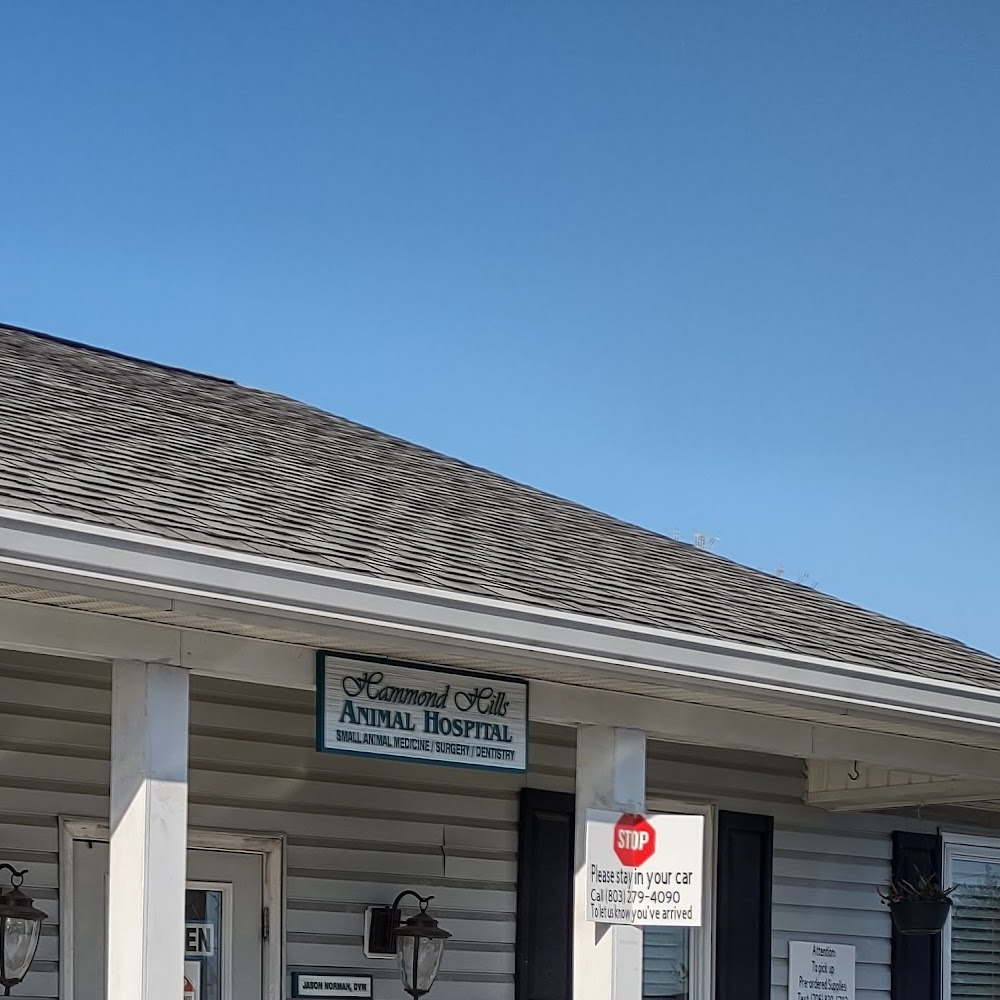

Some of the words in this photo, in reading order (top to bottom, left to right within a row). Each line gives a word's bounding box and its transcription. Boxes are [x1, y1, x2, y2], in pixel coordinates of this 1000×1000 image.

[342, 671, 450, 708] Hammond
[454, 687, 510, 717] Hills
[339, 700, 415, 731] ANIMAL
[423, 709, 513, 742] HOSPITAL
[336, 729, 361, 744] SMALL
[363, 732, 392, 747] ANIMAL
[393, 736, 429, 752] MEDICINE
[435, 741, 470, 757] SURGERY
[476, 745, 516, 761] DENTISTRY
[618, 829, 649, 851] STOP
[591, 864, 614, 884] Please
[616, 868, 633, 889] stay
[634, 868, 643, 884] in
[646, 872, 672, 890] your
[675, 872, 693, 885] car
[591, 888, 604, 902] Call
[605, 889, 626, 904] (803)
[627, 890, 681, 904] 279-4090
[591, 903, 599, 918] To
[608, 909, 614, 918] us
[614, 904, 631, 919] know
[631, 905, 660, 923] you've
[662, 905, 693, 920] arrived
[185, 927, 211, 952] EN
[811, 960, 818, 972] To
[818, 962, 828, 975] pick
[302, 981, 323, 990] JASON
[353, 982, 367, 991] DVM
[798, 975, 828, 990] Pre-ordered
